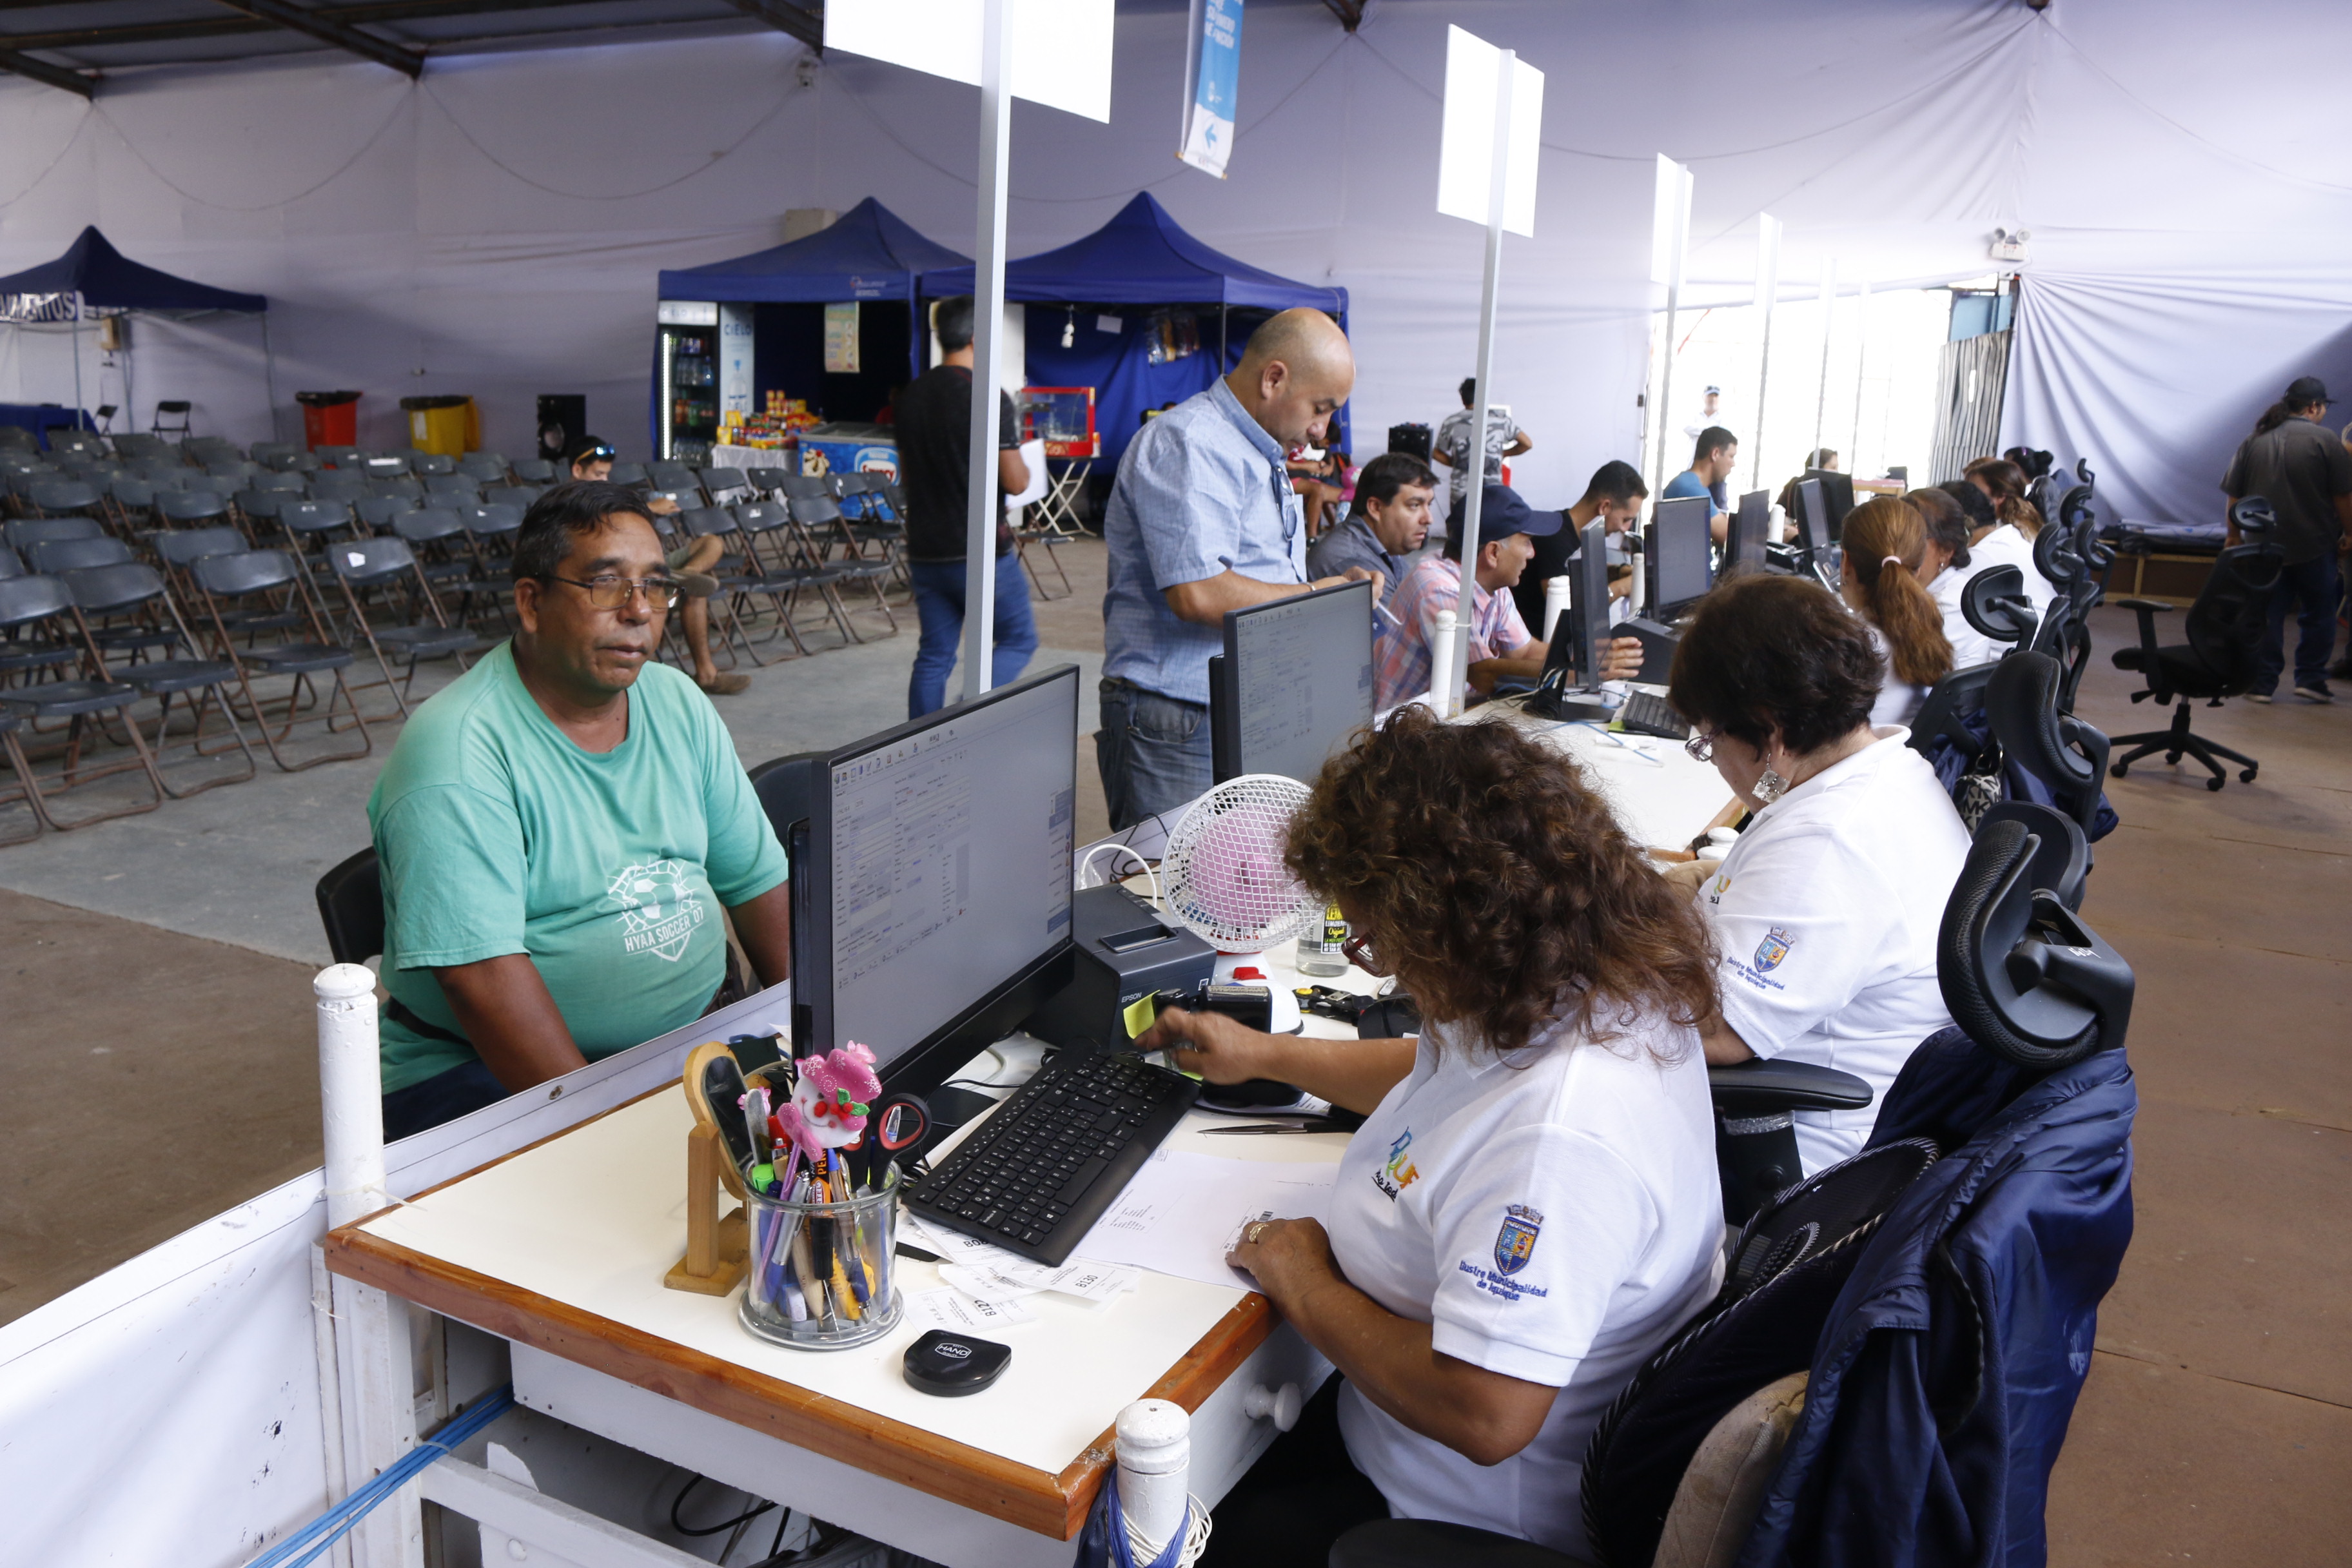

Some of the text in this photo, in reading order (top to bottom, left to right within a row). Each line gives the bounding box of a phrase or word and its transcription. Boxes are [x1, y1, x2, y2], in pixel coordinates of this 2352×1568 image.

[624, 906, 704, 952] HYAA SOCCER '07
[1745, 966, 1785, 990] Municipalidad
[1121, 992, 1142, 1003] EPSON
[1075, 1275, 1099, 1288] B130
[1476, 1279, 1520, 1301] de Iquique
[1487, 1271, 1548, 1297] Municipalidad
[938, 1345, 968, 1356] HAND
